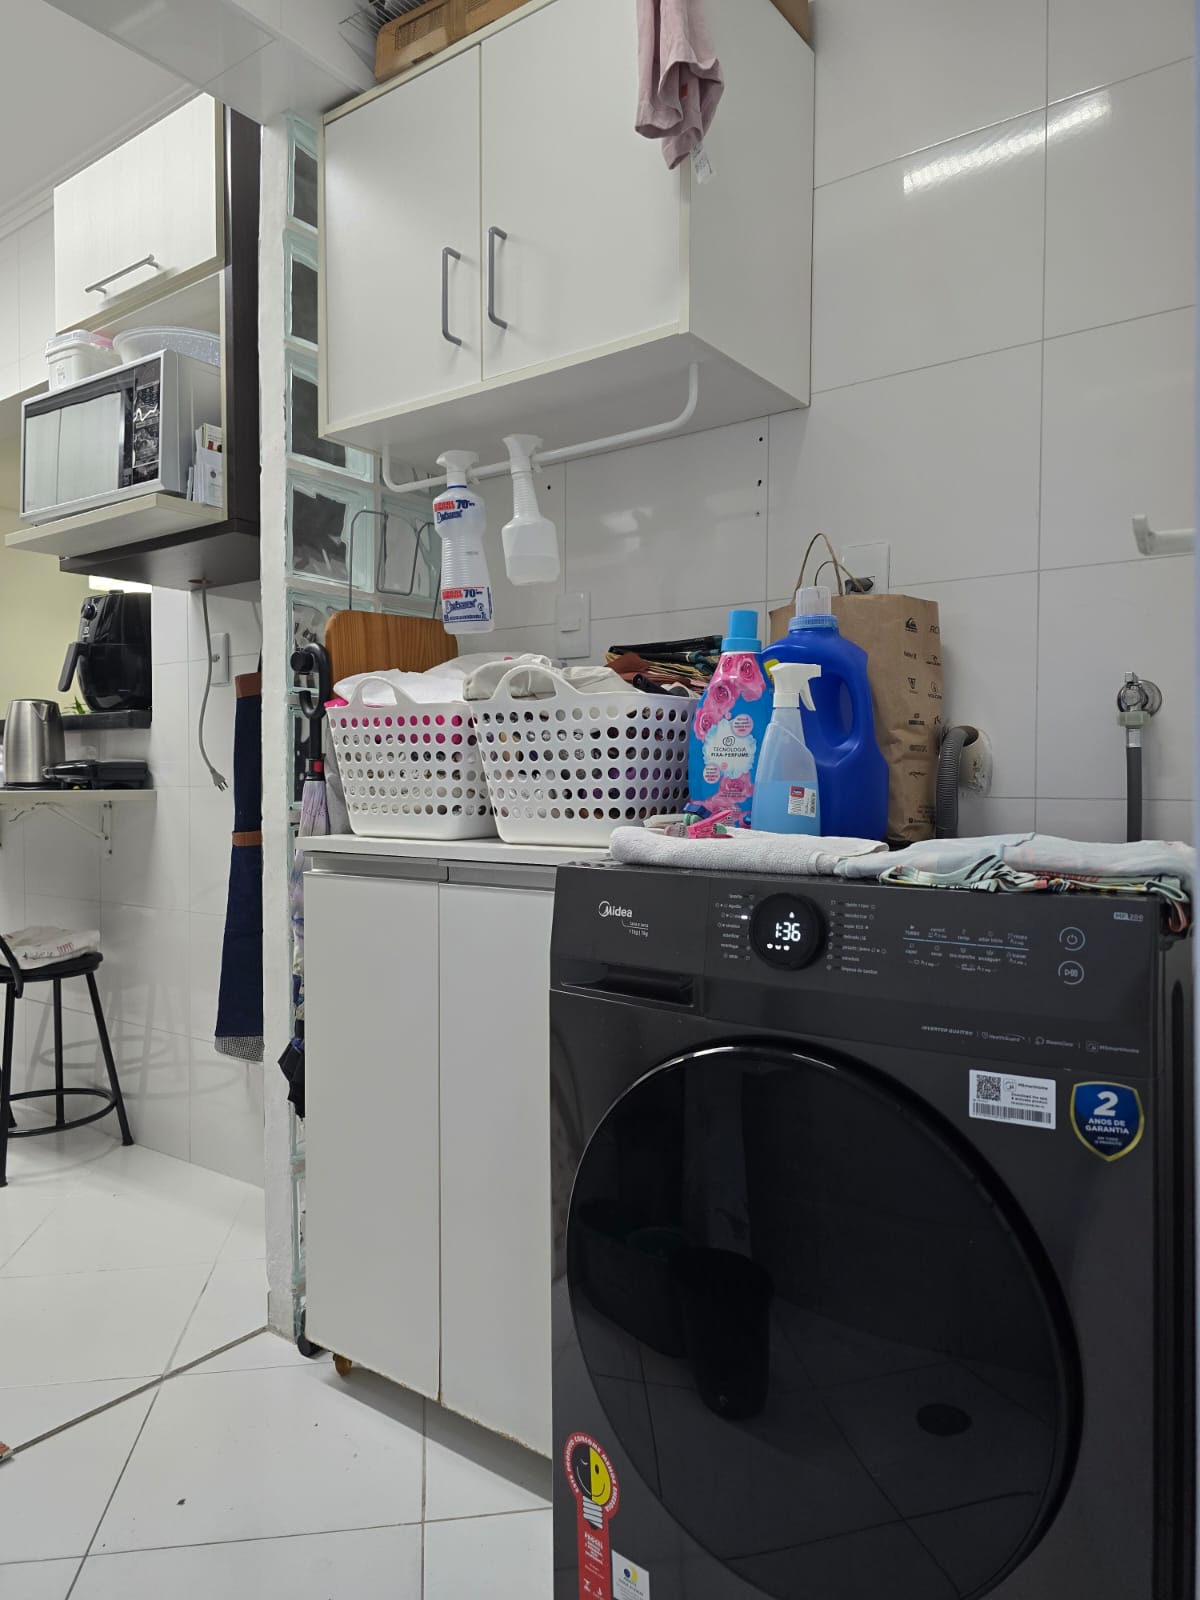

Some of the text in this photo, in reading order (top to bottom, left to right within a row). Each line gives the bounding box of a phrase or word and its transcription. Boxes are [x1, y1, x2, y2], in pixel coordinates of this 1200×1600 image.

[598, 900, 633, 918] Midea
[775, 921, 801, 942] 1:36
[1093, 1090, 1118, 1117] 2
[1085, 1125, 1129, 1135] GARANTIA
[1088, 1118, 1126, 1127] ANOS DE
